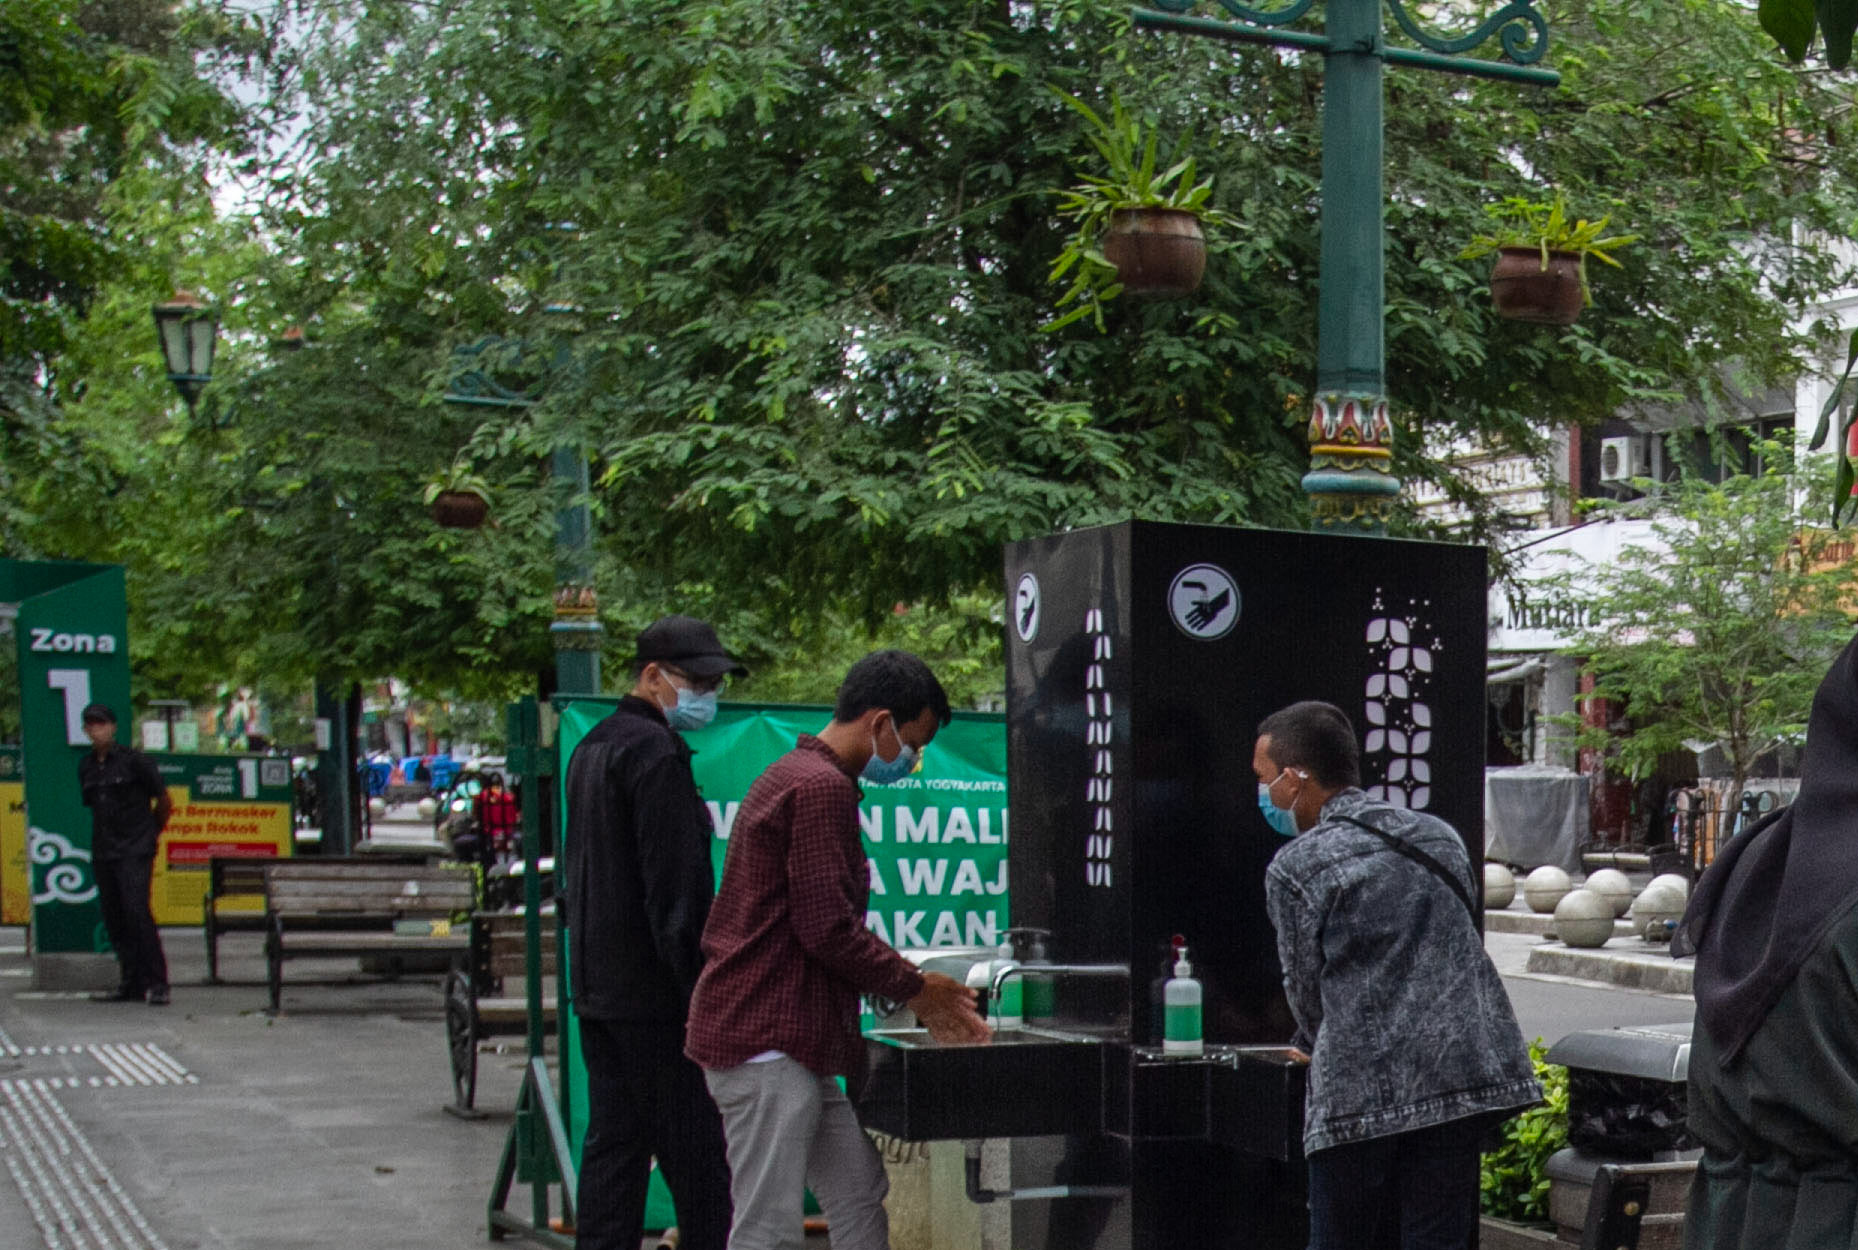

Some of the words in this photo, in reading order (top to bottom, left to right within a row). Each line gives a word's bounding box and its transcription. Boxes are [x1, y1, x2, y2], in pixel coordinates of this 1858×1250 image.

[30, 628, 116, 653] Zona
[48, 669, 94, 746] 1
[238, 760, 258, 798] 1
[925, 778, 1006, 793] YOGYAKARTA
[206, 821, 259, 836] Rokok
